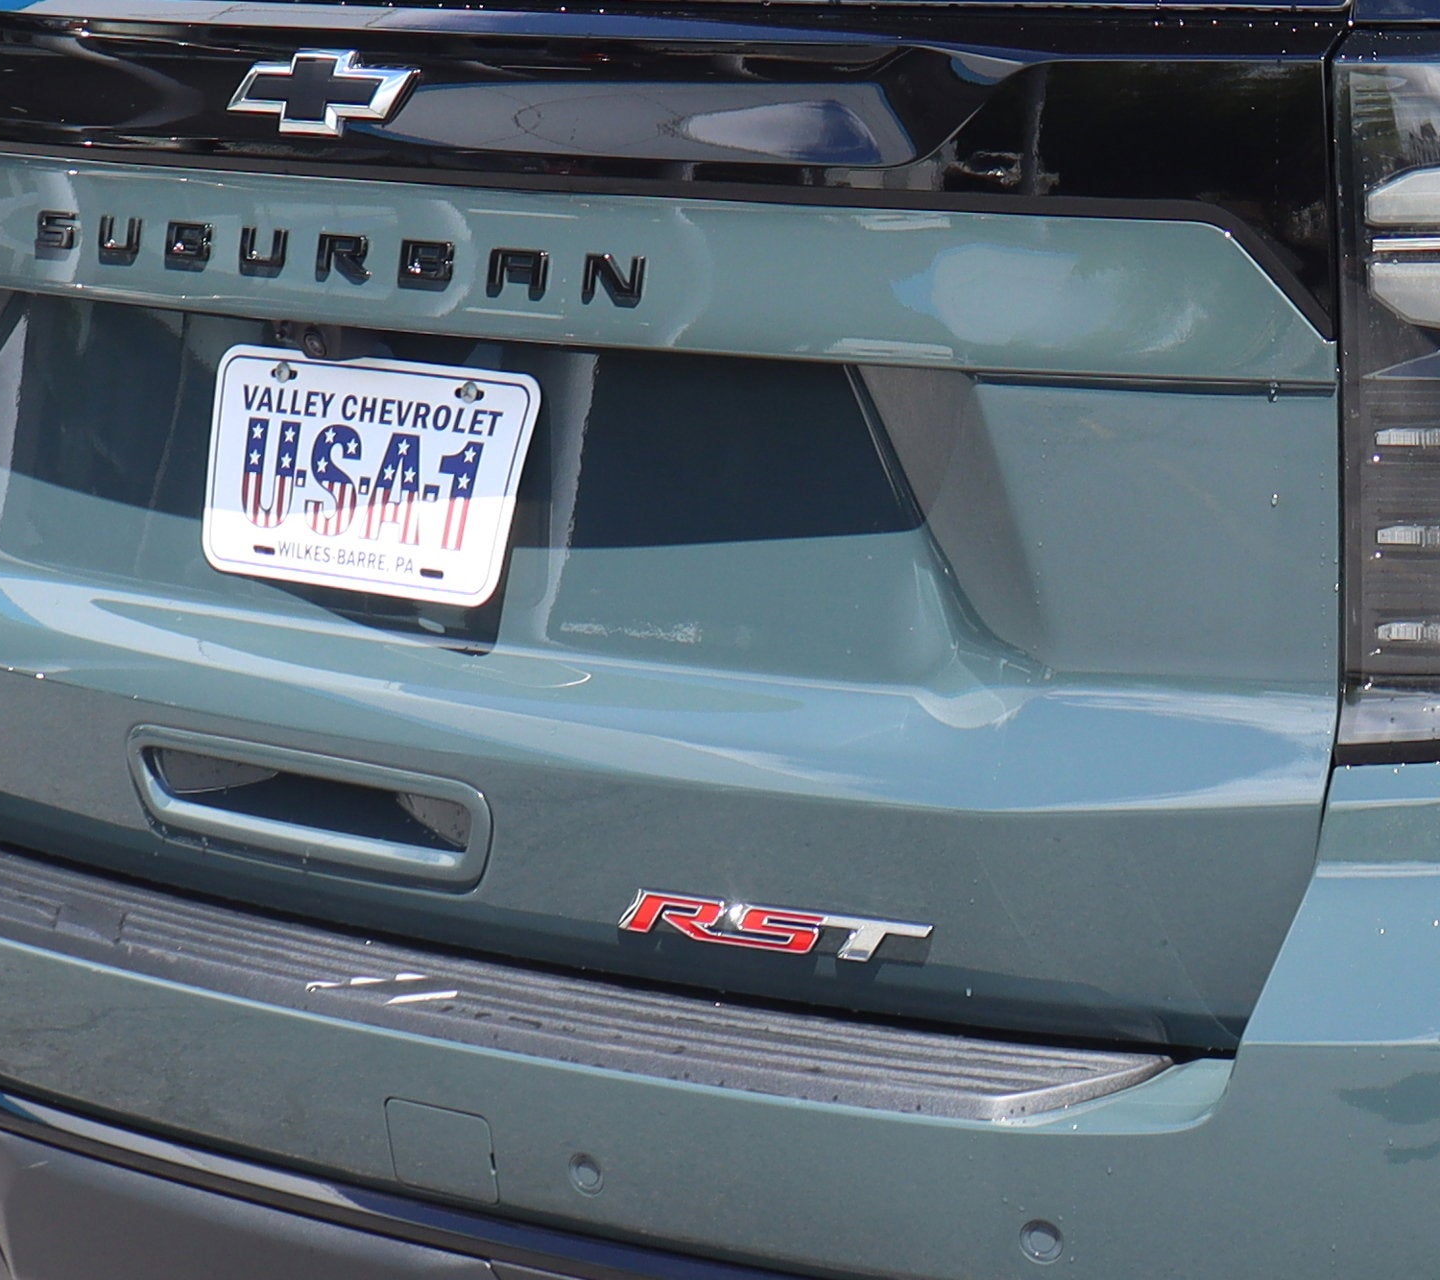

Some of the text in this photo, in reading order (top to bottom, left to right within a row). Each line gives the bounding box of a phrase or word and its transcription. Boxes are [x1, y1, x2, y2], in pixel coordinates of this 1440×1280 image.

[34, 210, 648, 308] SUBURBAN
[243, 384, 504, 437] VALLEY CHEVROLET
[395, 551, 414, 574] PA
[617, 887, 934, 963] RST
